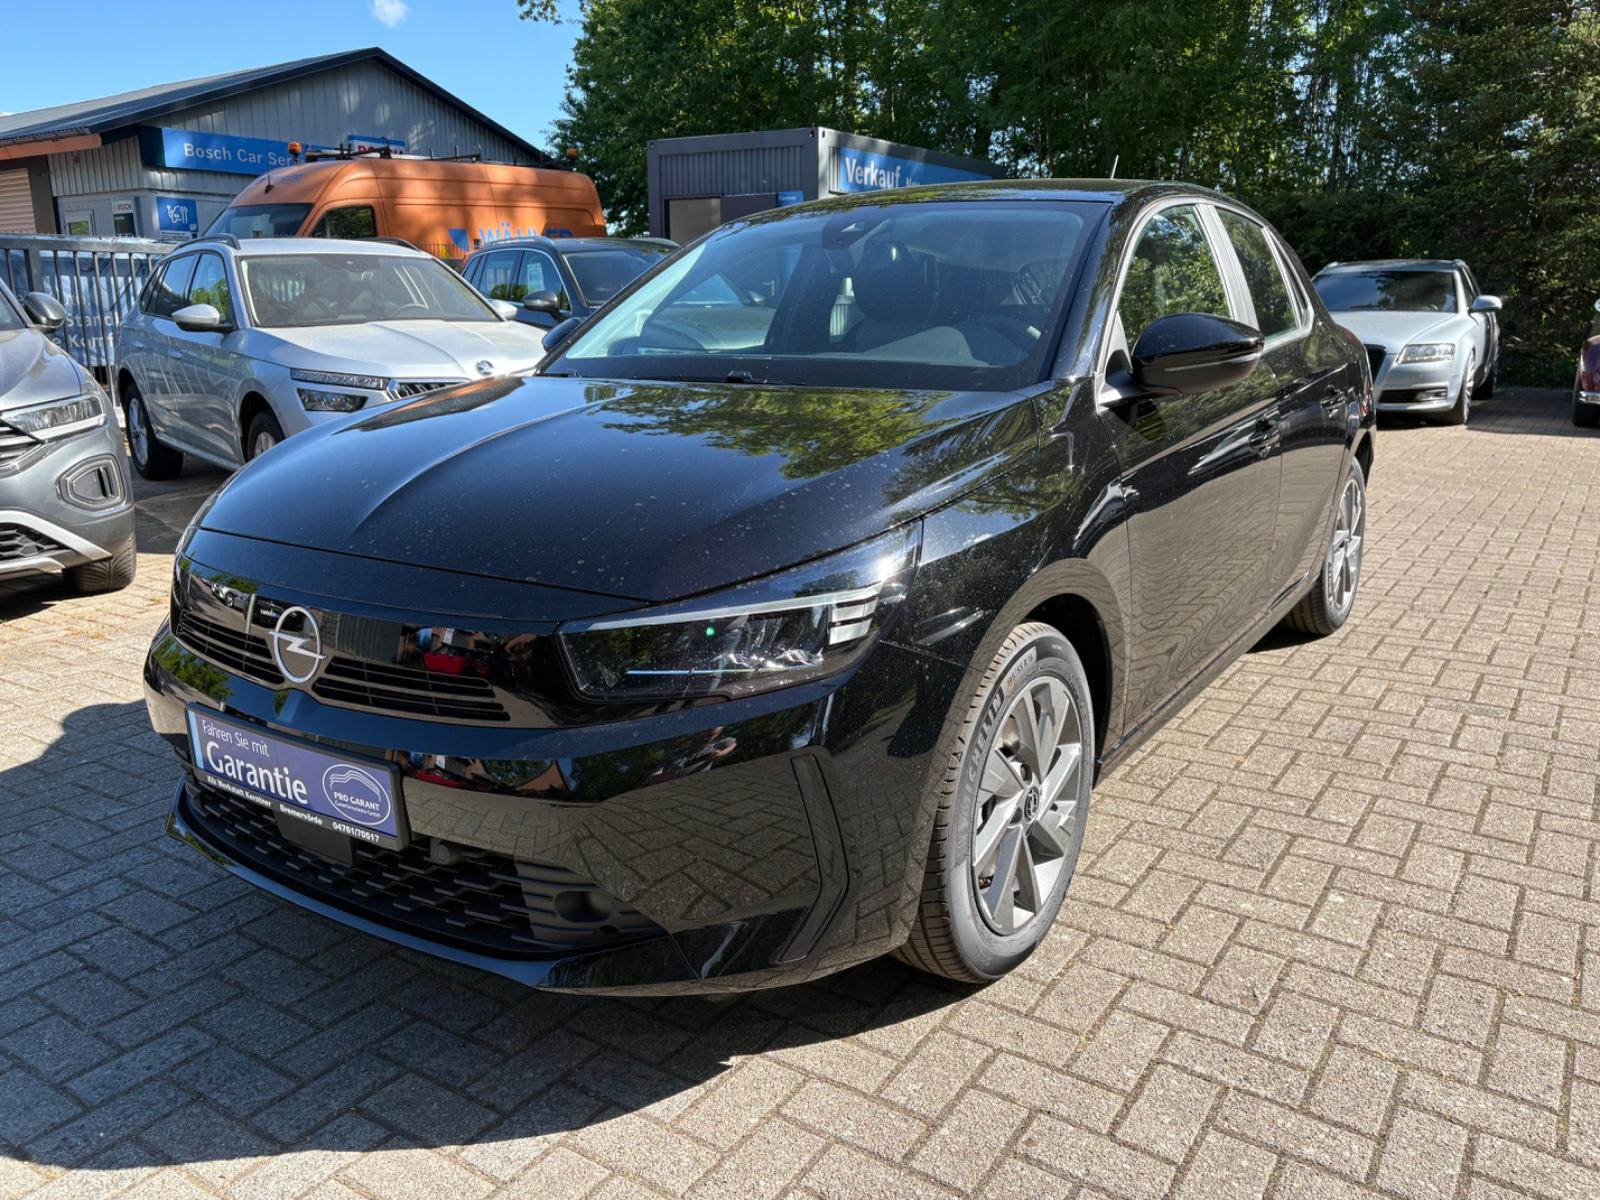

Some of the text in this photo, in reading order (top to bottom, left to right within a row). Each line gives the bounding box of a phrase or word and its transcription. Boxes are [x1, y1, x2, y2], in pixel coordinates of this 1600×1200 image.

[184, 142, 231, 160] Bosch
[237, 148, 262, 164] Car
[845, 156, 902, 190] Verkauf
[202, 719, 270, 757] Fahren Sie mit
[206, 740, 309, 805] Garantie
[333, 791, 380, 811] PRO GARANT
